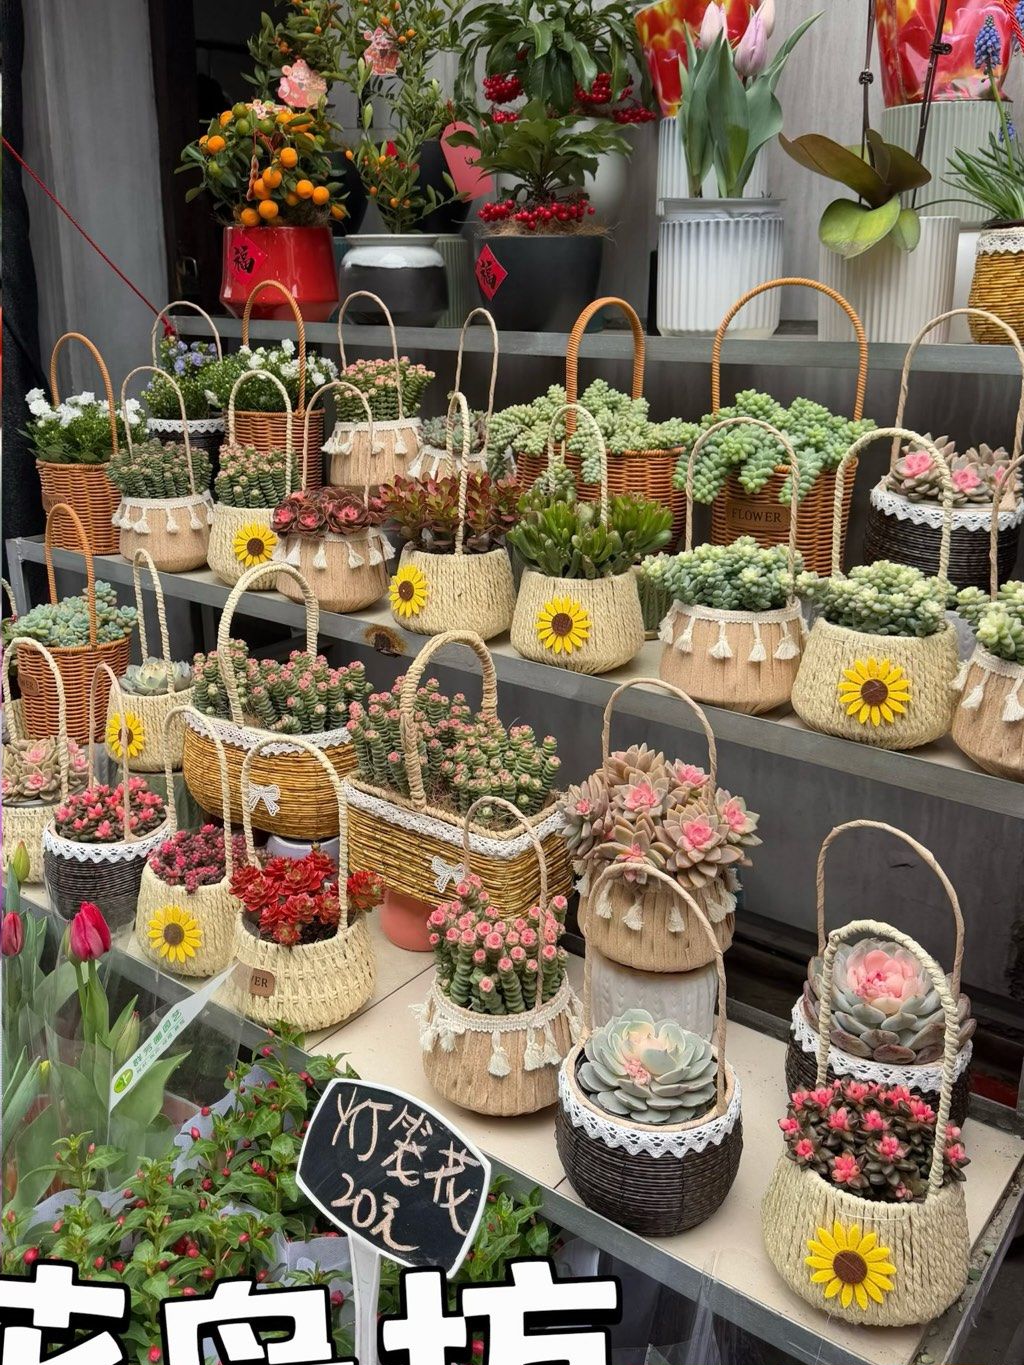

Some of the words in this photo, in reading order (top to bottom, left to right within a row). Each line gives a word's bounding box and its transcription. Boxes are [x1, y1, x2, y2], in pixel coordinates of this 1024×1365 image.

[731, 507, 782, 523] FLOWER
[332, 1087, 481, 1237] 灯笼花
[330, 1172, 420, 1252] 20元
